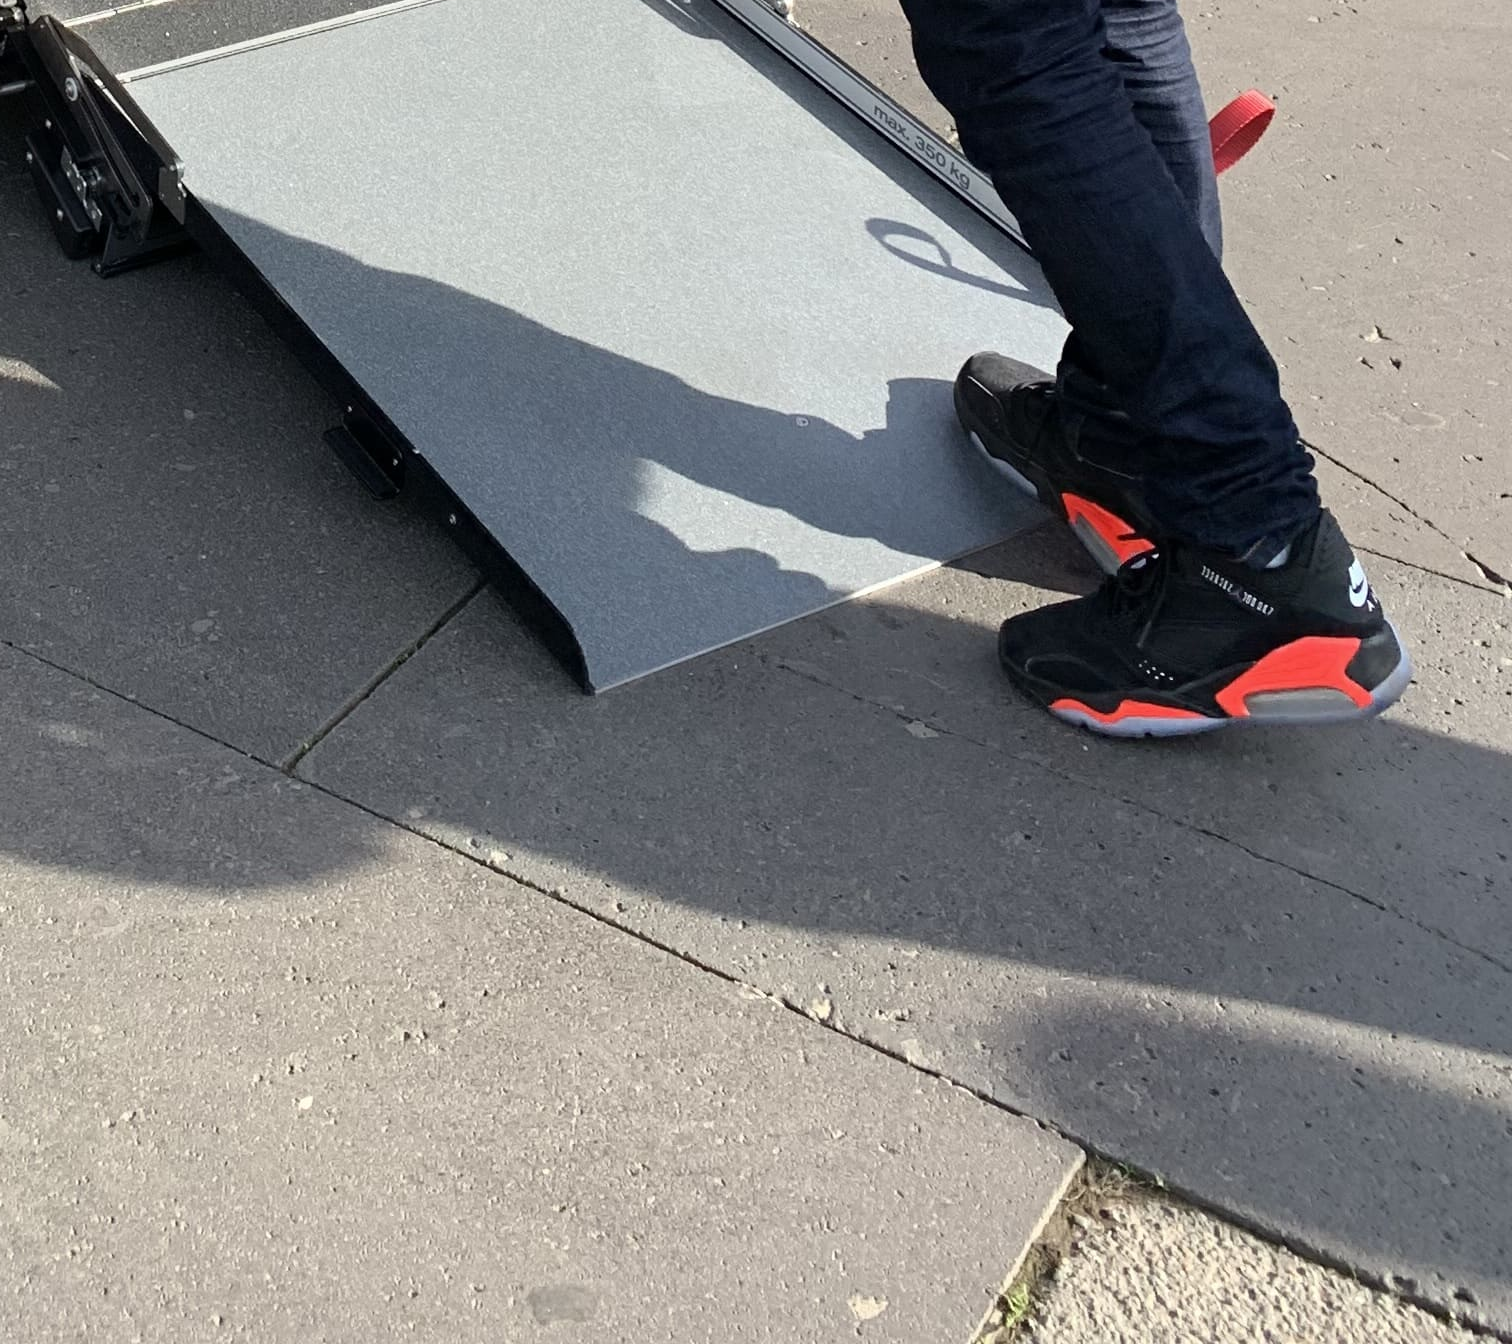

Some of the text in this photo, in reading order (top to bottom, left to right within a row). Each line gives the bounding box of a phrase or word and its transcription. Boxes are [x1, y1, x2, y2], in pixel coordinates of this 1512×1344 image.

[873, 104, 971, 191] max. 350 kg
